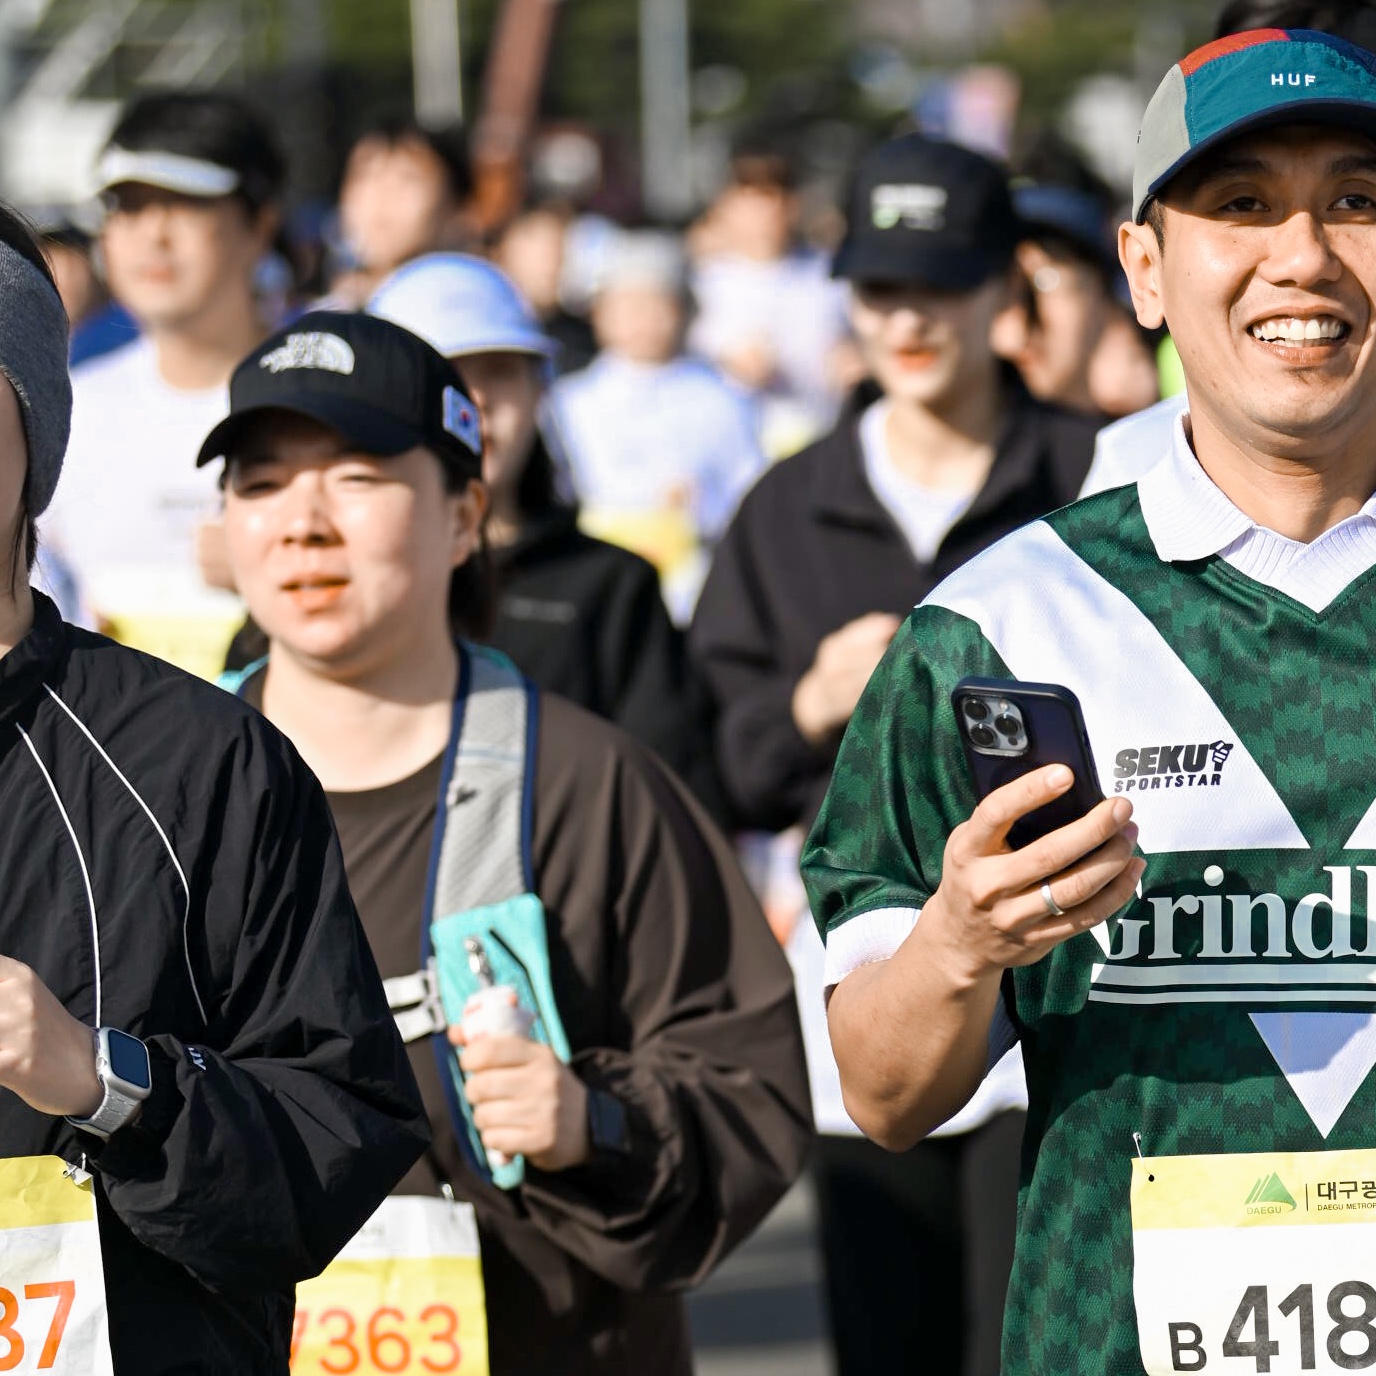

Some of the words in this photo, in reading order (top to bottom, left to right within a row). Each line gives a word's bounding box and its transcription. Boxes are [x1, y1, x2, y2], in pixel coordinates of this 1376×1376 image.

[1270, 73, 1316, 87] HUF
[1114, 774, 1221, 793] SPORTSTAR
[1247, 1206, 1282, 1215] DAEGU
[1317, 1203, 1344, 1211] DAEGU
